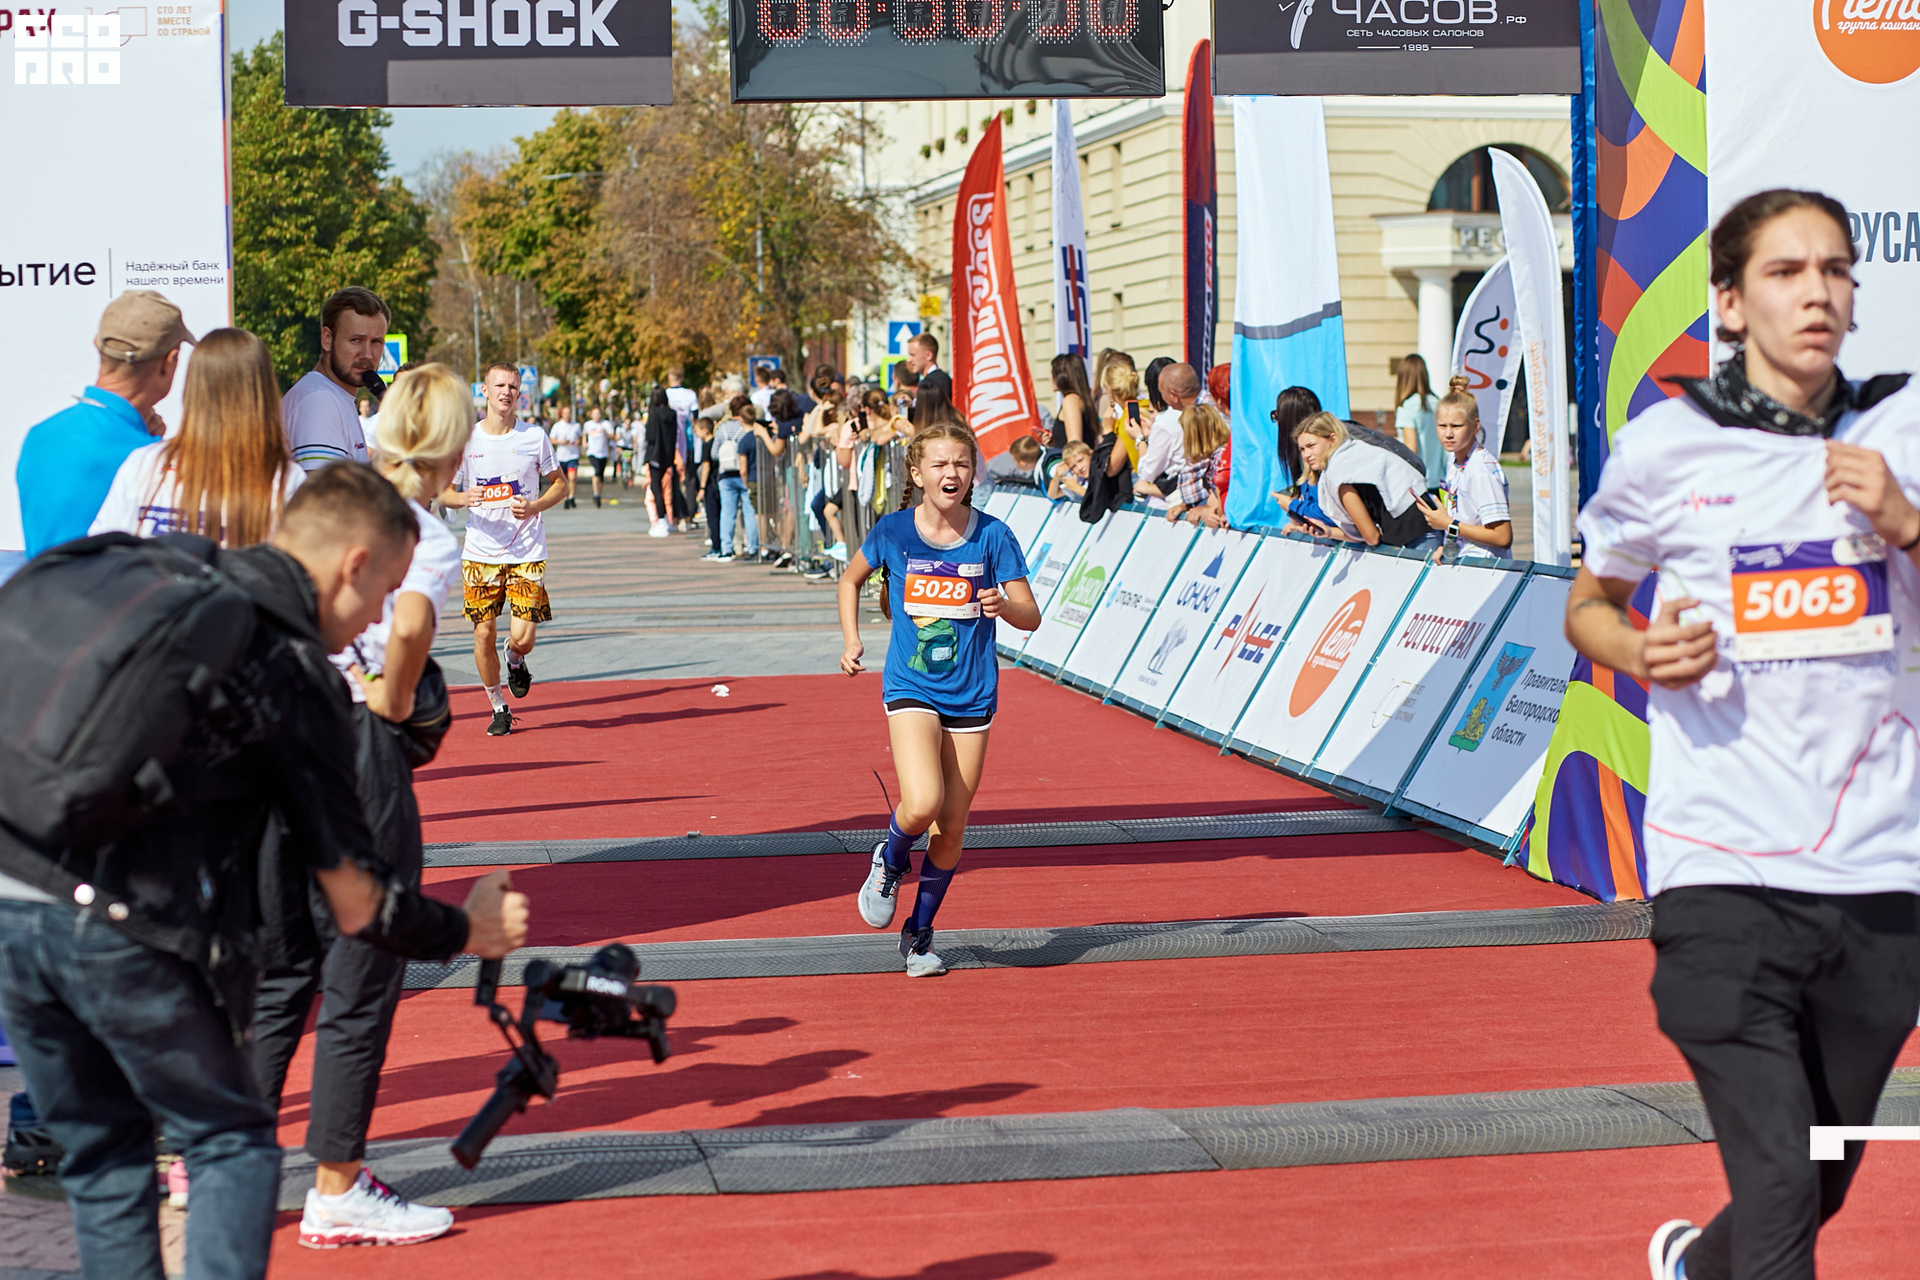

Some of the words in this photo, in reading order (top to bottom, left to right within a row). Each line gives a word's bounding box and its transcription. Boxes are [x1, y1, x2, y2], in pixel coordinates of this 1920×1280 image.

[156, 6, 174, 15] СТО
[176, 6, 193, 15] ЛЕТ
[156, 17, 192, 26] ВМЕСТЕ
[337, 0, 620, 47] G-SHOCK
[1837, 21, 1879, 35] группа
[156, 28, 171, 37] СО
[172, 26, 212, 36] СТРАНОЙ
[1346, 29, 1374, 38] СЕТЬ
[1376, 29, 1430, 38] ЧАСОВЫХ
[1432, 29, 1485, 38] САЛОНОВ
[1402, 43, 1430, 52] 1995
[125, 260, 189, 272] Надёжный
[192, 260, 220, 271] банк
[125, 275, 170, 287] нашего
[173, 274, 224, 287] времени
[910, 578, 968, 600] 5028
[1743, 574, 1858, 622] 5063
[1396, 612, 1487, 660] РОСГОССТРАХ
[1520, 668, 1568, 695] Правитель
[1505, 694, 1561, 725] Белгородско
[1491, 722, 1528, 747] области
